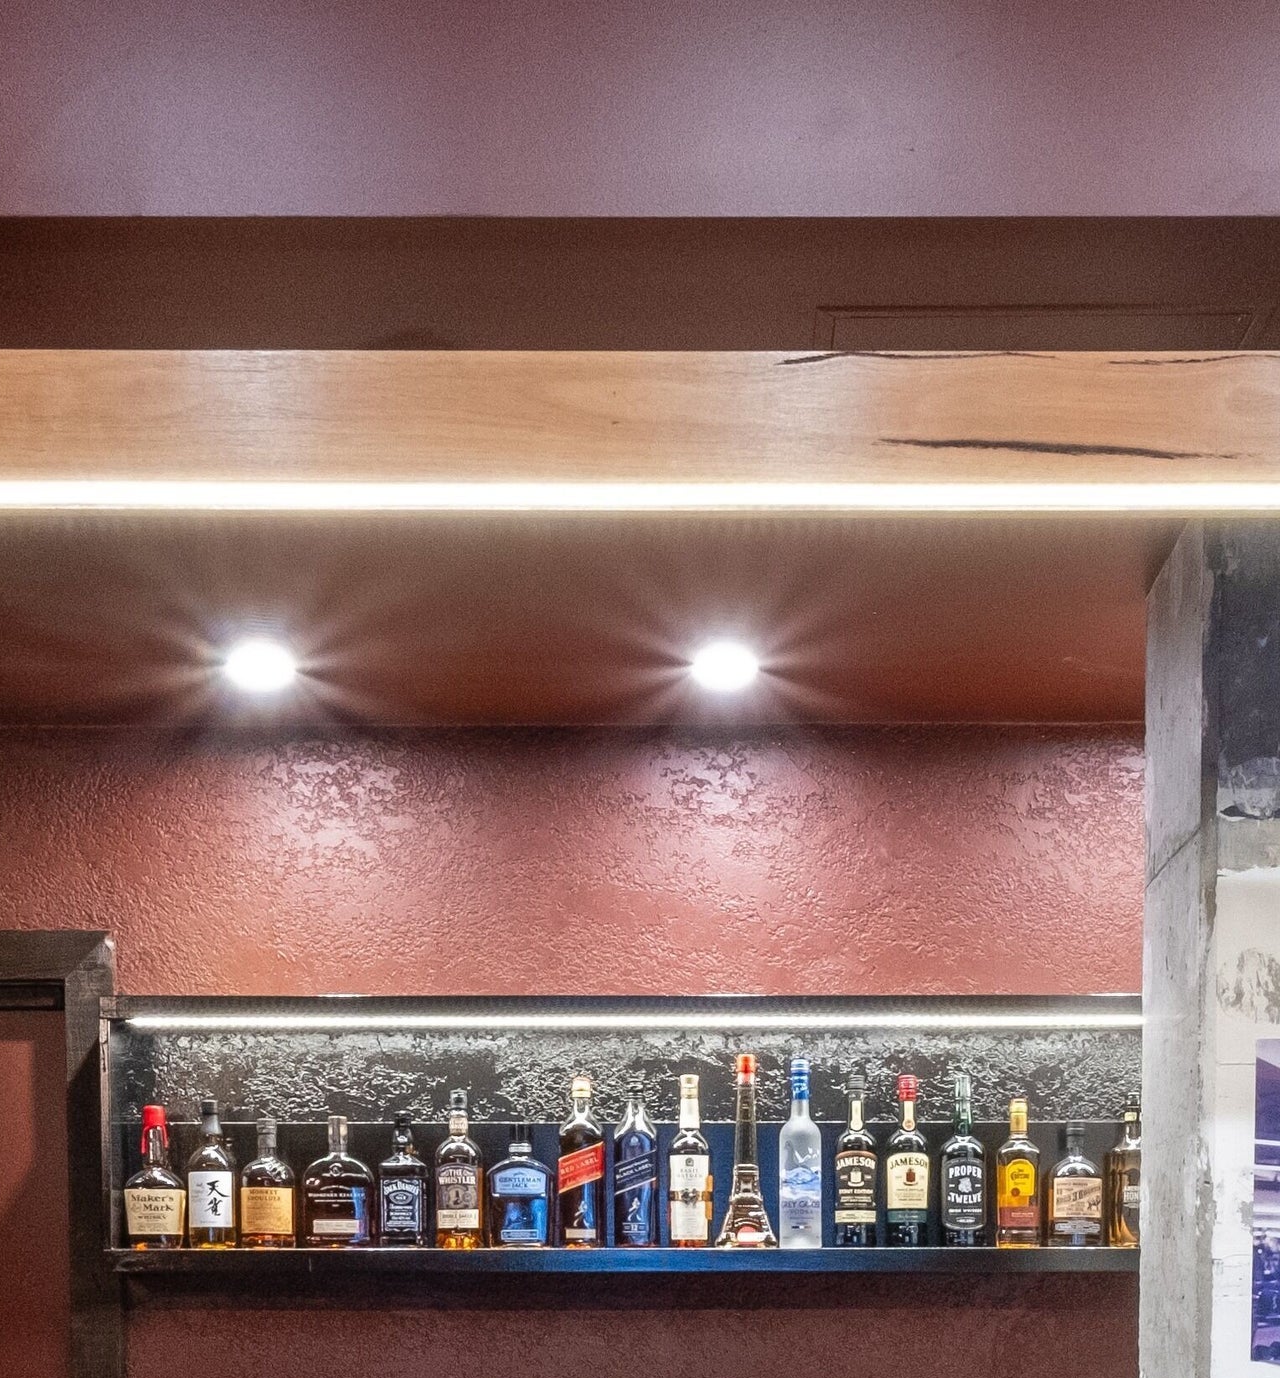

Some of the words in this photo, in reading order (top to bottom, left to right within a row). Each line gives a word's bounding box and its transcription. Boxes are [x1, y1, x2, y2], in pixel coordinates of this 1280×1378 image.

[836, 1156, 876, 1171] JAMESON
[889, 1157, 928, 1170] JAMESON
[449, 1169, 465, 1177] THE
[615, 1169, 632, 1180] BLACK
[632, 1163, 653, 1176] LABEL
[948, 1165, 982, 1179] PROPER
[438, 1176, 476, 1185] WHISTLER
[131, 1194, 174, 1202] Maker's
[950, 1192, 983, 1204] TWELVE
[143, 1203, 175, 1212] Mark
